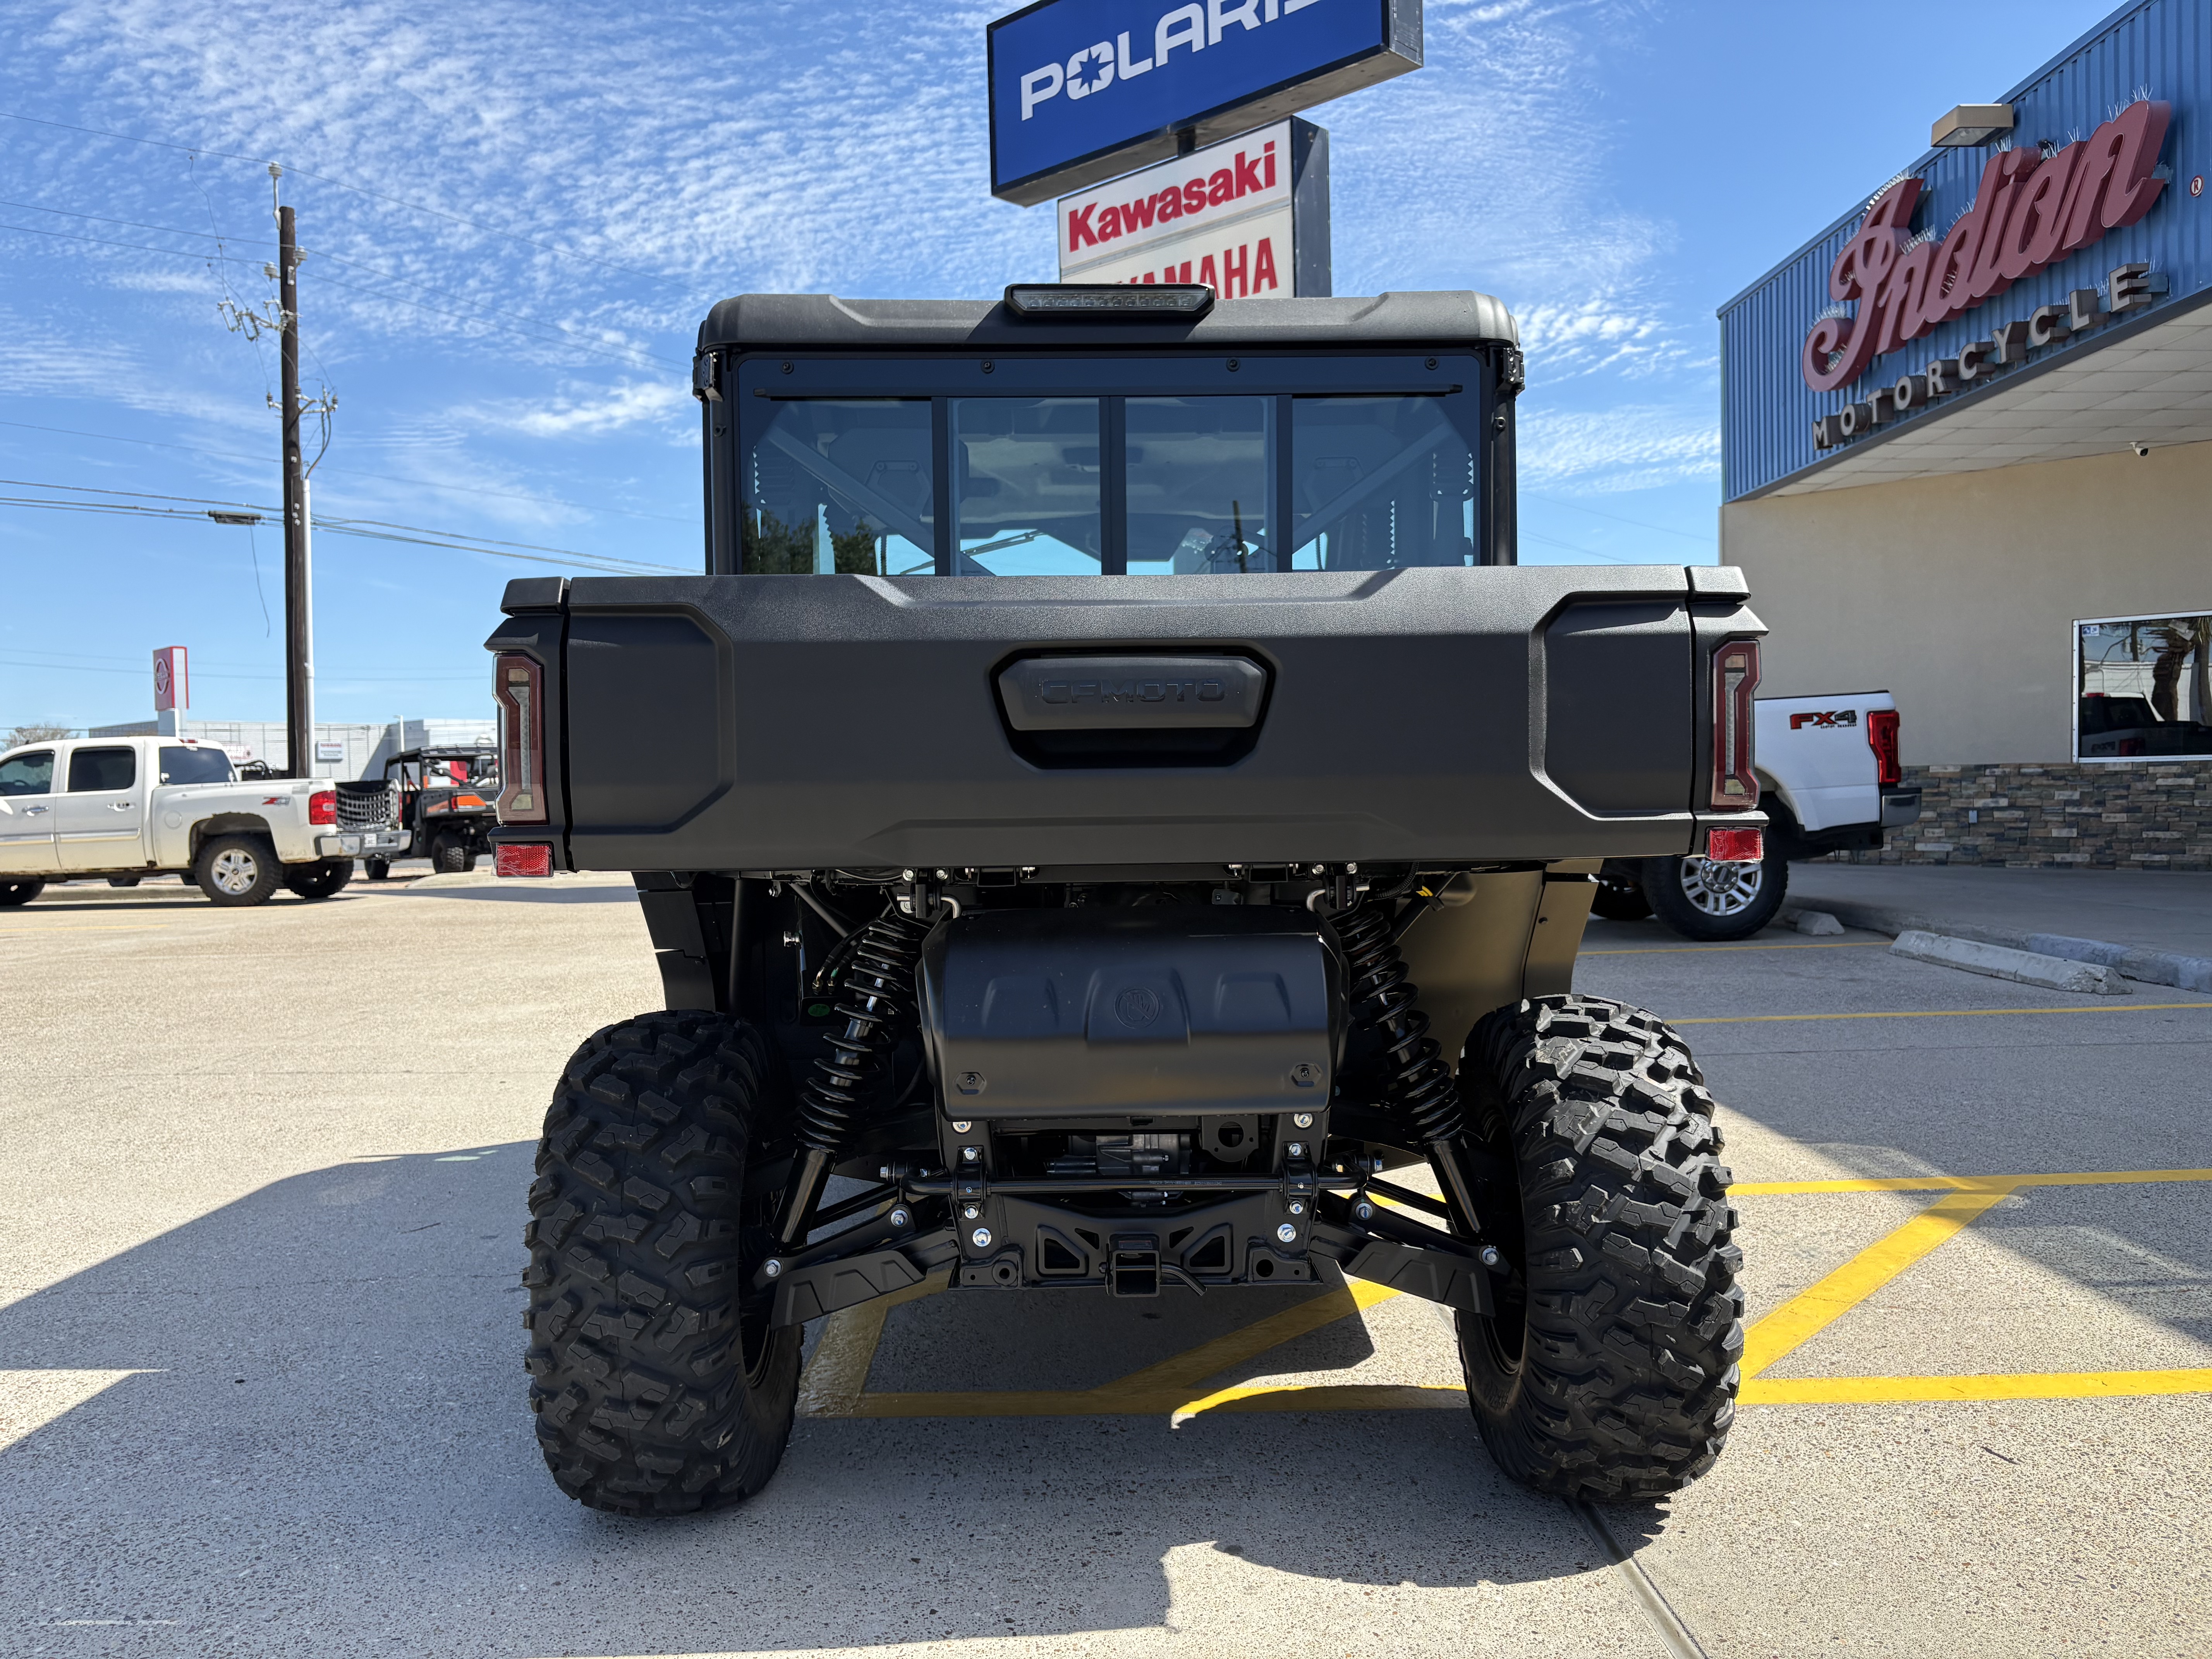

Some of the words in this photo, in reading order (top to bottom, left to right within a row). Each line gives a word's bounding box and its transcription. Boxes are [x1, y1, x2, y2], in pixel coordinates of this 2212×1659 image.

[1020, 0, 1320, 121] POLAR
[1068, 141, 1276, 252] Kawasaki
[1802, 100, 2170, 392] Indian
[1116, 237, 1278, 299] AHA
[1812, 262, 2152, 450] MOTORCYCLE
[1042, 678, 1226, 704] CFMOTO
[1790, 710, 1857, 730] FX4
